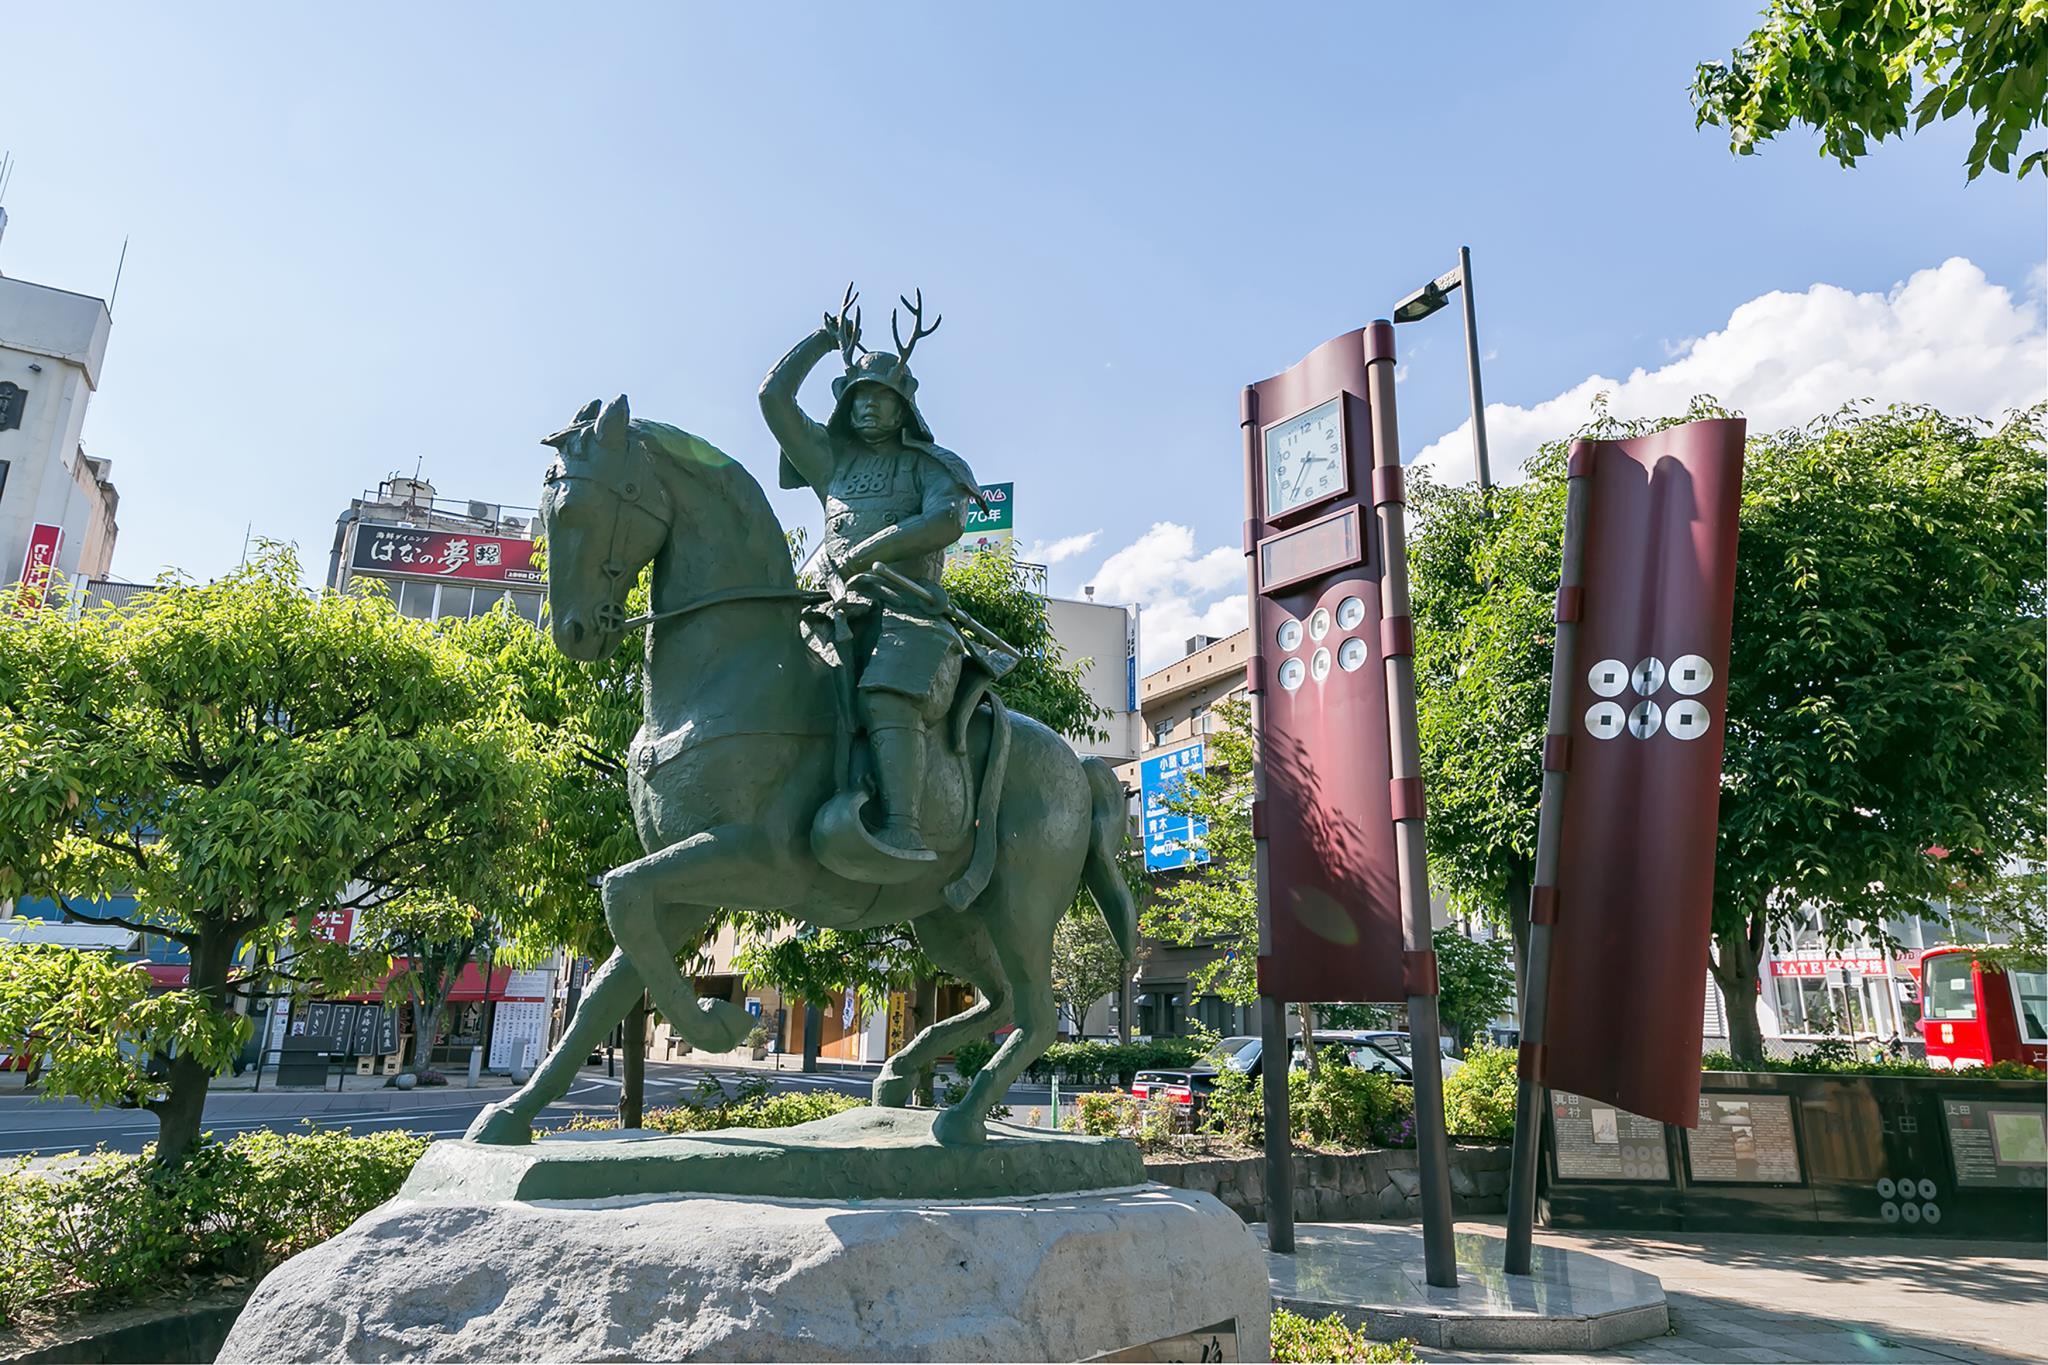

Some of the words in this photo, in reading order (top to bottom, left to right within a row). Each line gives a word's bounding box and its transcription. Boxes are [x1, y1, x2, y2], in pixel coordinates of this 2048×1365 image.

[370, 538, 470, 574] はなの夢
[316, 911, 345, 926] サヒ
[1947, 1104, 1970, 1115] 上田
